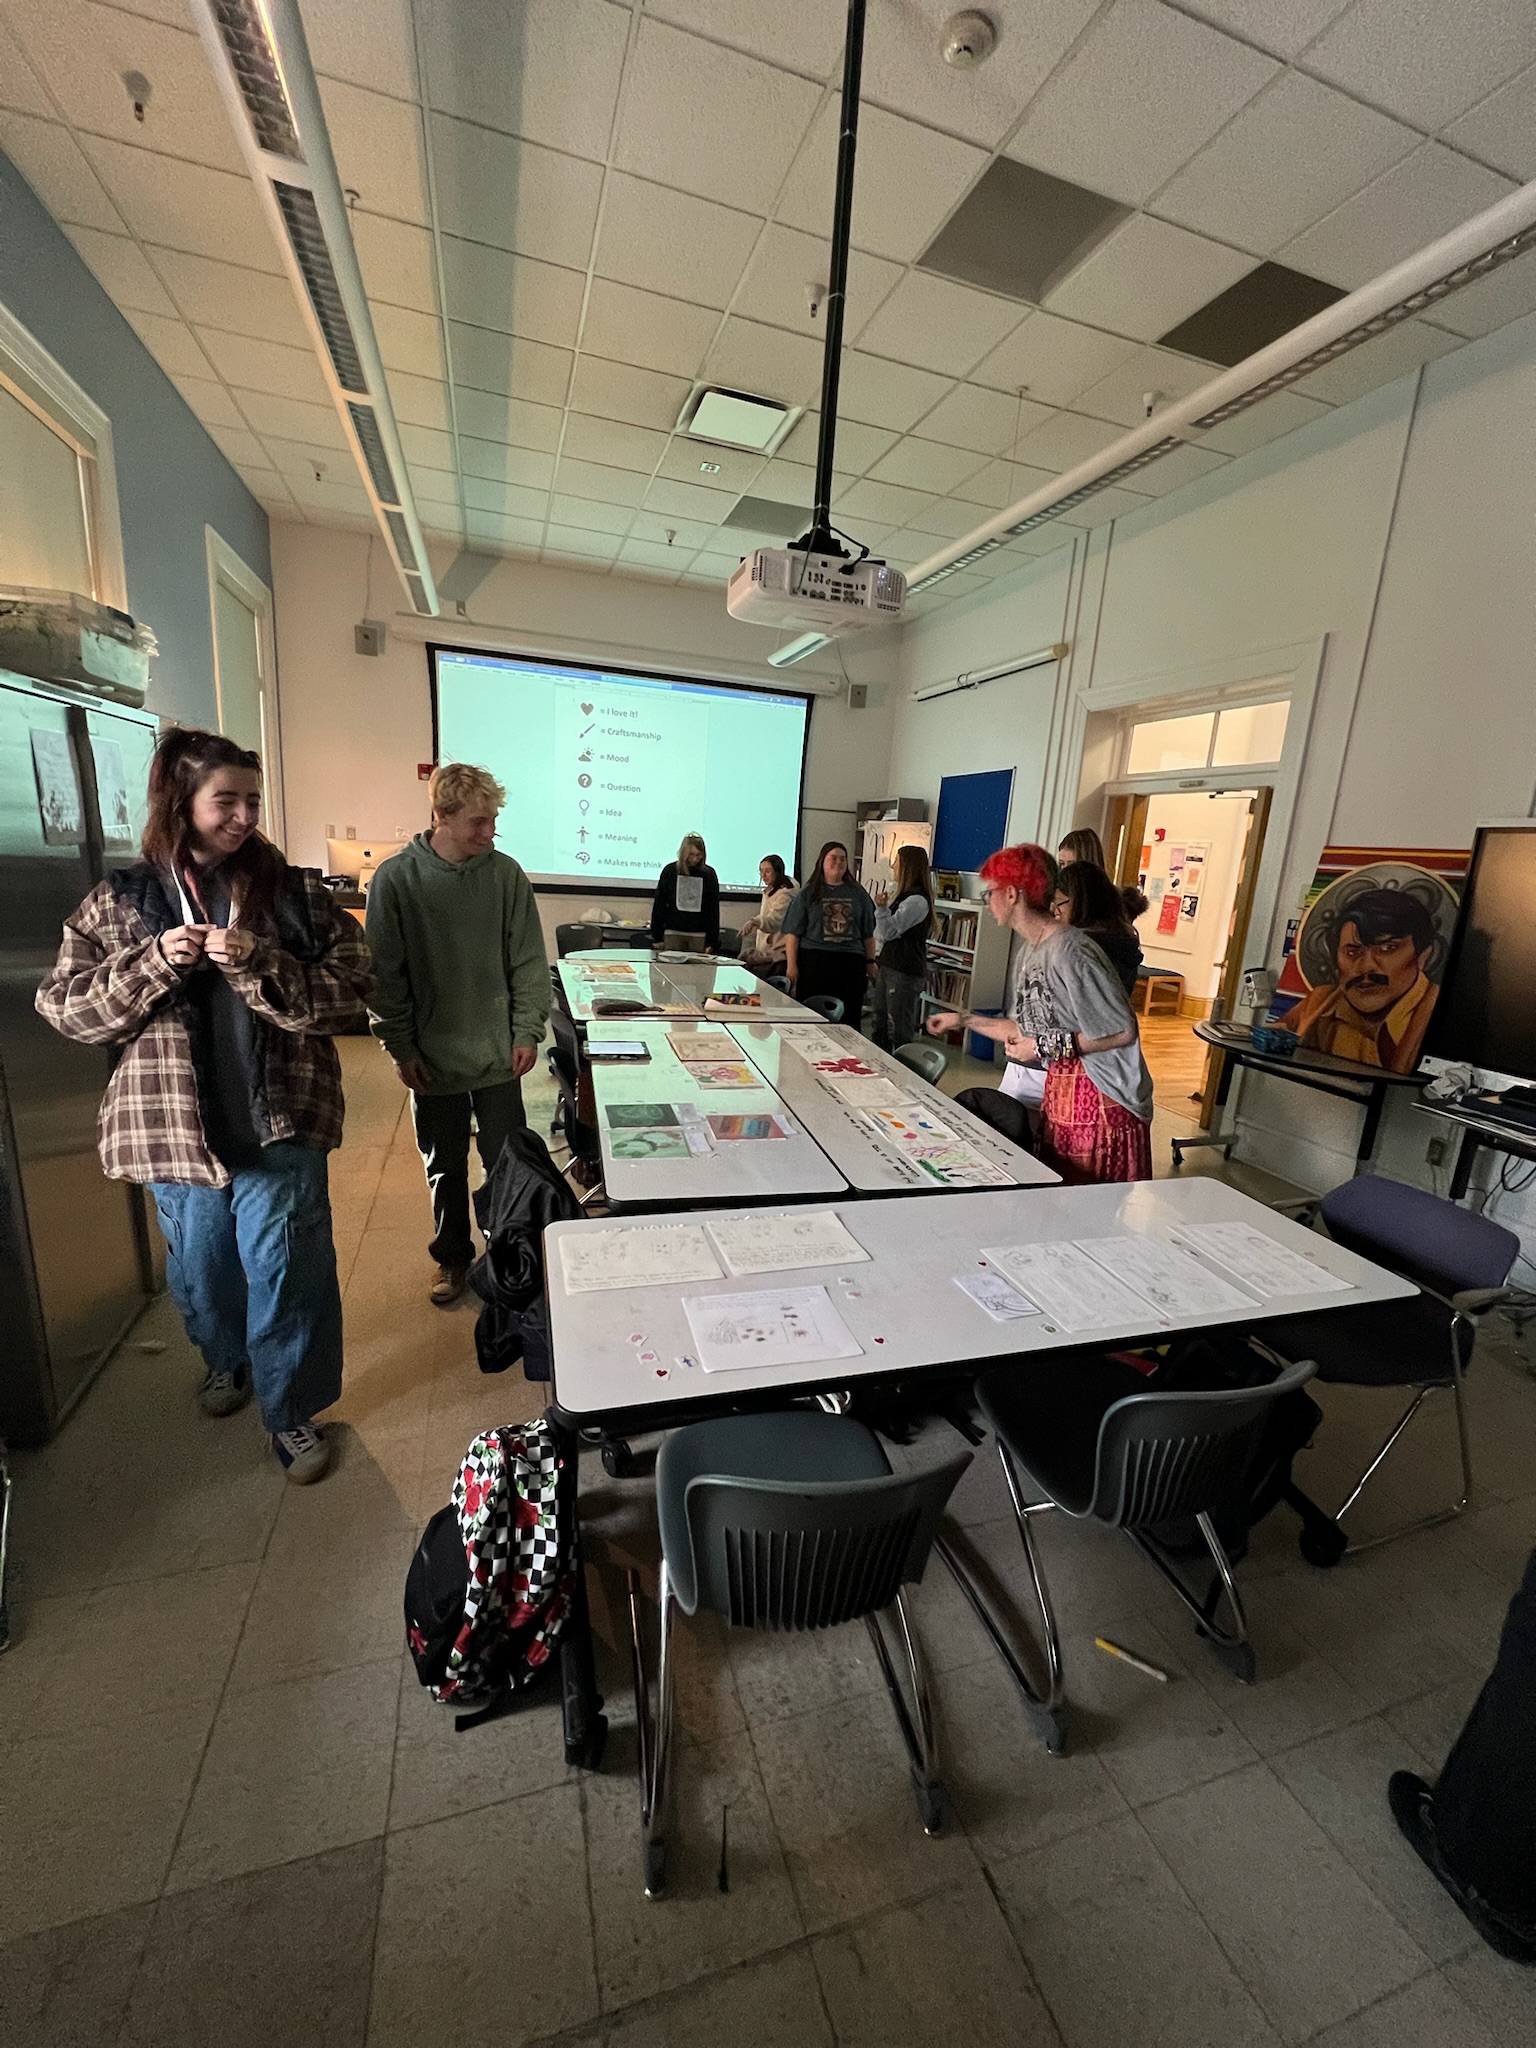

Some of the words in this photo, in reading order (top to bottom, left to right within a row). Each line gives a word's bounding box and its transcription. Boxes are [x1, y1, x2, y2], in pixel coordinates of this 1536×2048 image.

[611, 708, 628, 718] love
[629, 710, 638, 719] it!
[607, 727, 662, 741] Craftsmanship
[606, 754, 630, 763] Mood
[607, 783, 641, 792] Question
[606, 809, 622, 817] Idea
[605, 833, 638, 844] Meaning
[604, 858, 628, 867] Makes
[643, 861, 662, 869] think
